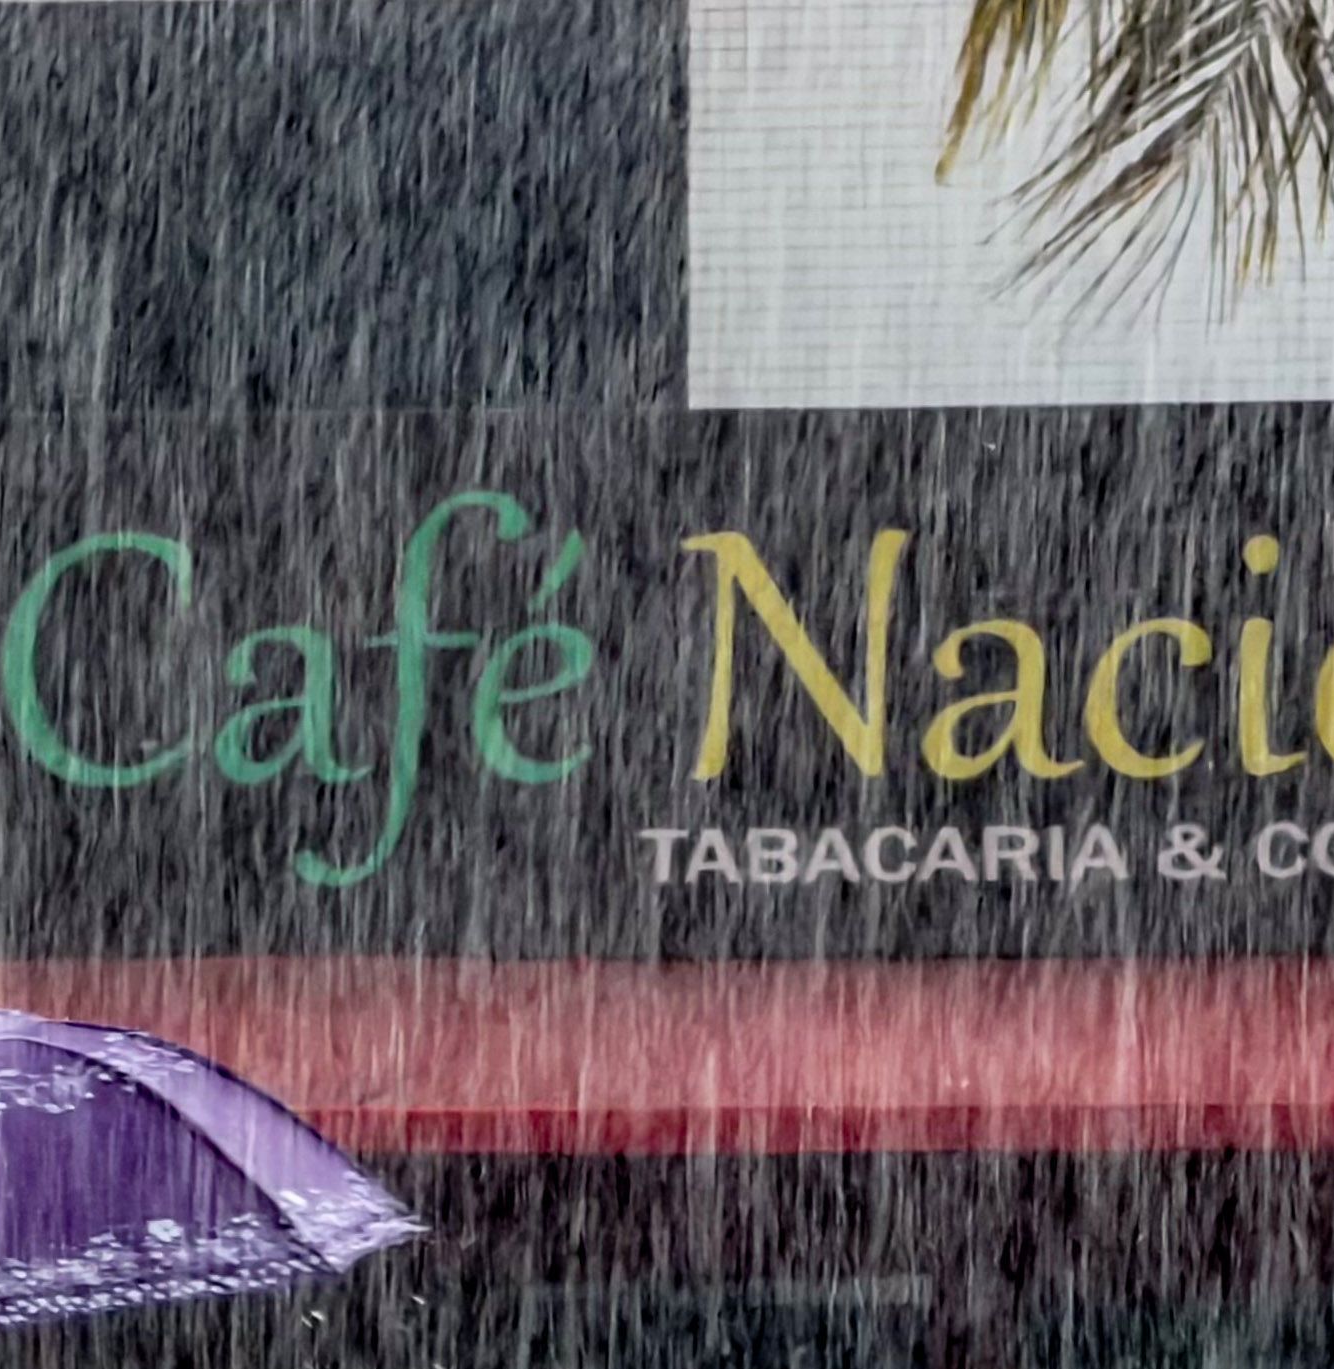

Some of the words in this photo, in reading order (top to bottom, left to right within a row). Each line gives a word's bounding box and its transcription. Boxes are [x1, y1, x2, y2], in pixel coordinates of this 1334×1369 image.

[0, 490, 595, 888] Café
[640, 824, 1130, 886] TABACARIA
[1159, 824, 1225, 884] &
